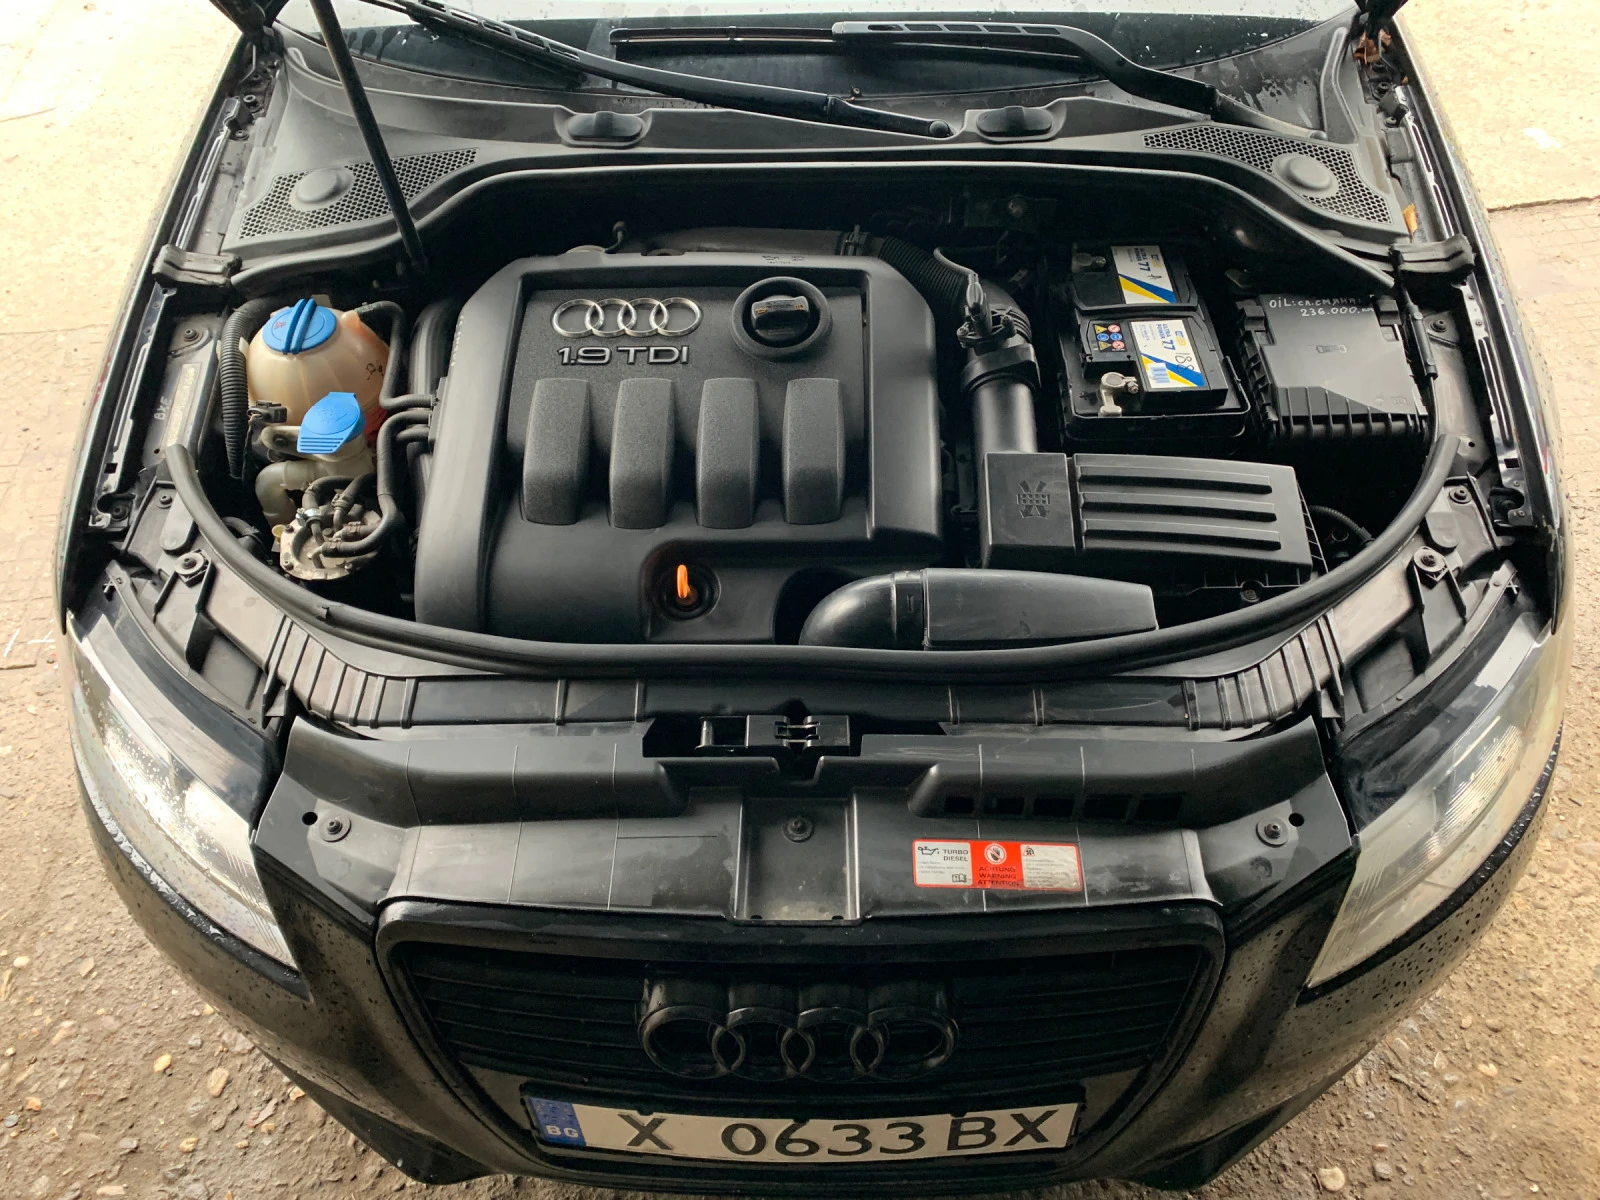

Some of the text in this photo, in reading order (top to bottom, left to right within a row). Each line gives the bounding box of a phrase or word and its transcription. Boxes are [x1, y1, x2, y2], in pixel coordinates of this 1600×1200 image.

[1138, 262, 1151, 271] 77
[1162, 340, 1176, 351] 77
[557, 345, 690, 365] 1.9 TDI
[977, 879, 1020, 887] ATTENTION
[546, 1124, 579, 1140] BG
[617, 1109, 1060, 1157] X 0633 BX
